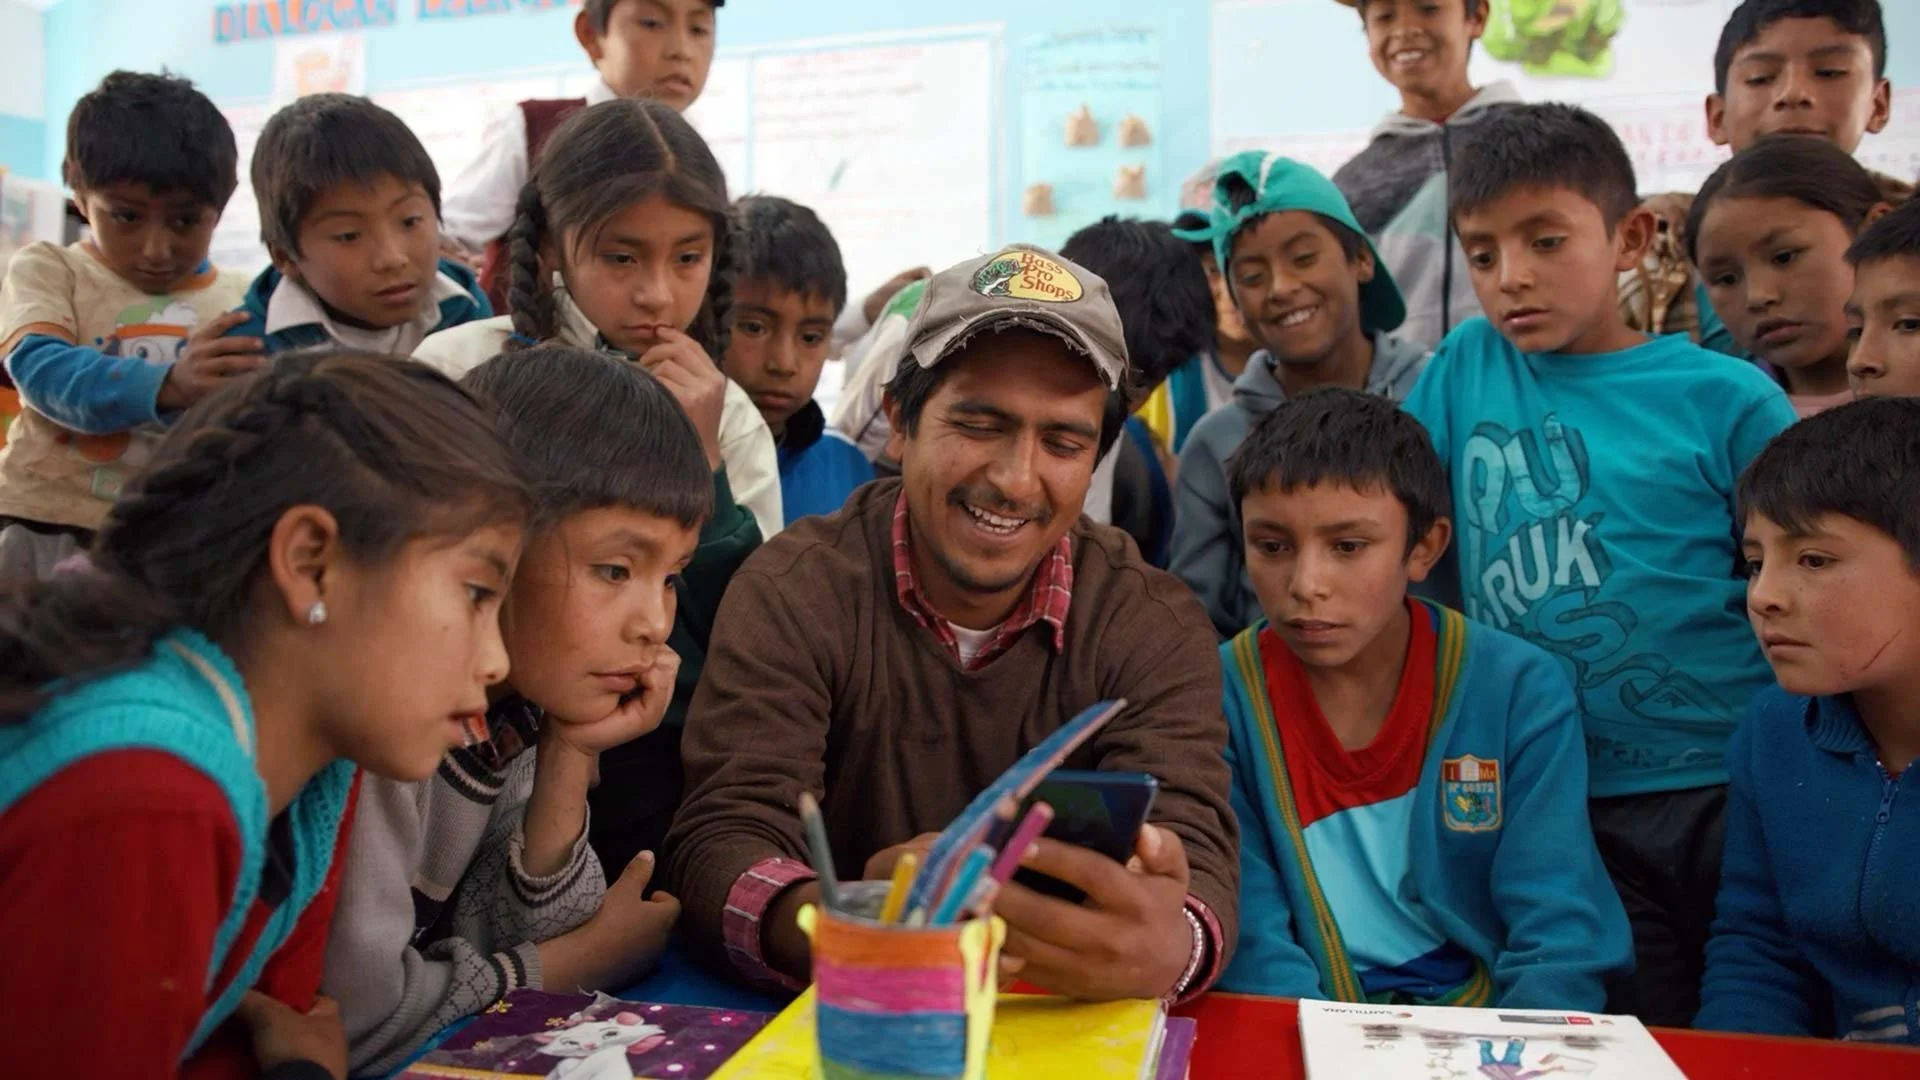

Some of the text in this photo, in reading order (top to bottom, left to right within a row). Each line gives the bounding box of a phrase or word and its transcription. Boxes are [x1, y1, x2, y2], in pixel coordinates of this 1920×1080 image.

[1021, 253, 1063, 274] Bass
[1022, 263, 1054, 282] Pro
[1020, 275, 1075, 300] Shops
